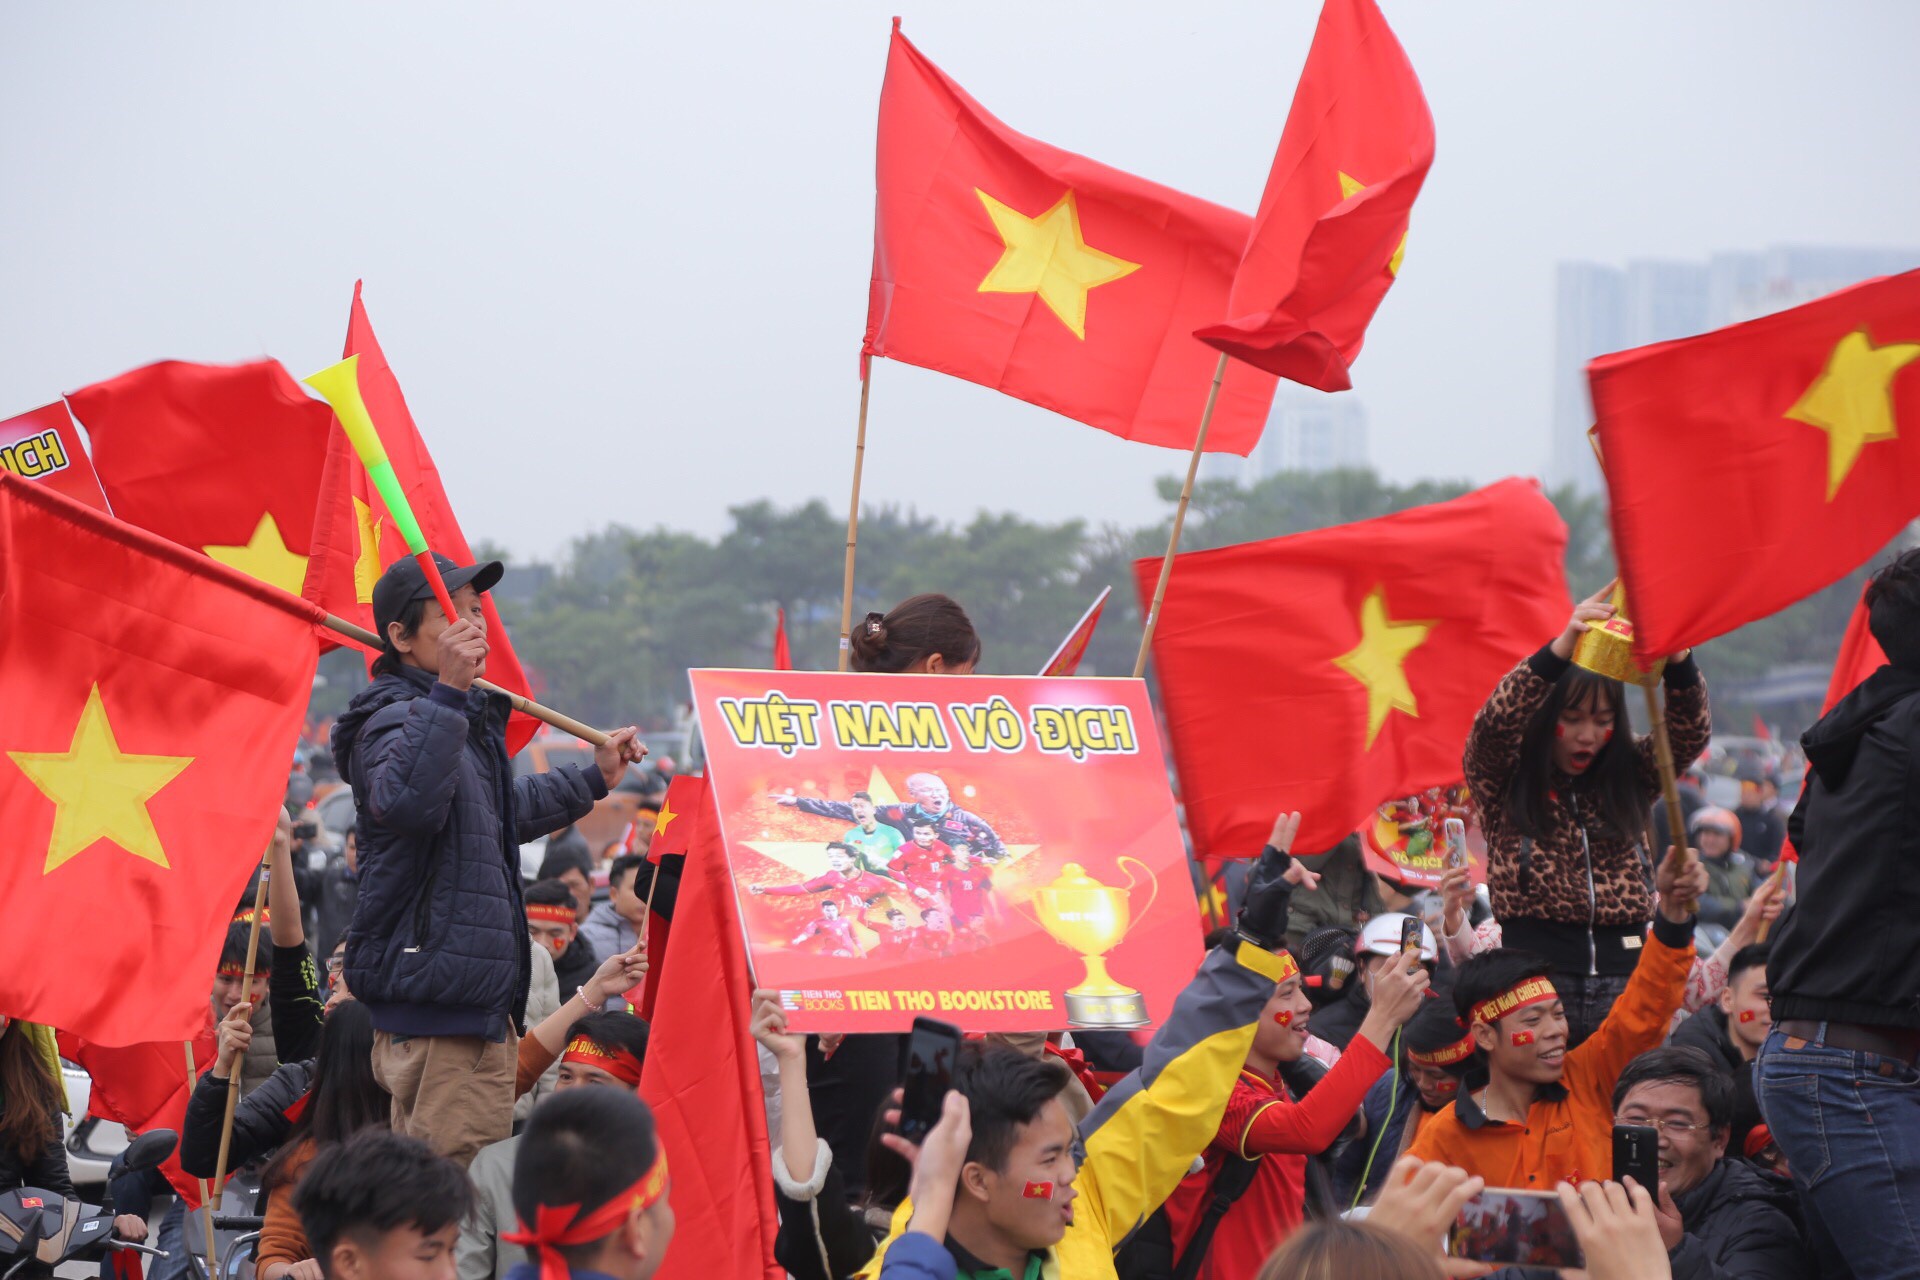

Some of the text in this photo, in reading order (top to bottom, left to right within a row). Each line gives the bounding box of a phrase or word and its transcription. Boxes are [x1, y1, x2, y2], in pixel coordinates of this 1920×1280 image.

[719, 692, 1135, 760] VIỆT NAM VÔ ĐỊCH
[801, 989, 842, 999] TIEN THO
[844, 989, 1054, 1012] TIEN THO BOOKSTORE
[804, 998, 845, 1011] BOOKS
